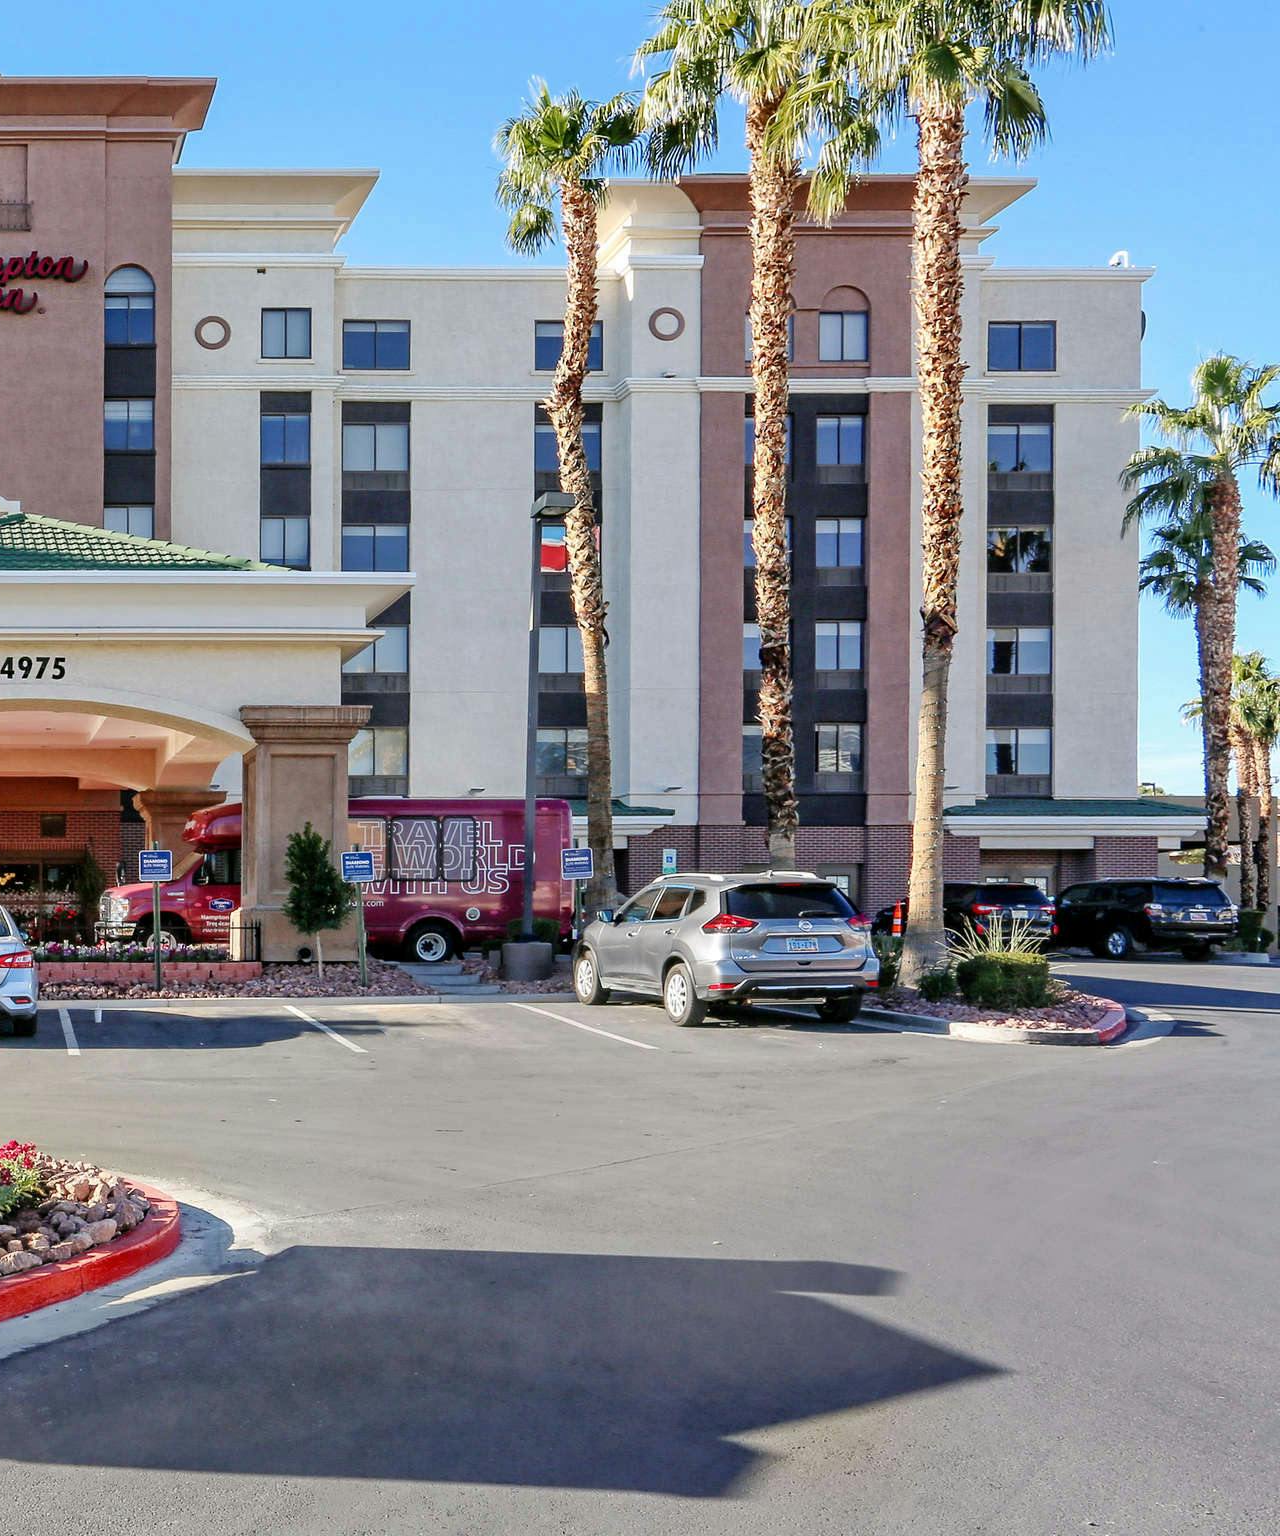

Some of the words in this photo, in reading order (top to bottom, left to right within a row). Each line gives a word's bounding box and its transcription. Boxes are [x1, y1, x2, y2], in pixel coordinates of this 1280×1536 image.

[0, 656, 66, 680] 4975
[358, 820, 503, 848] TRAVEL
[395, 844, 536, 871] WORLD
[460, 868, 510, 894] US
